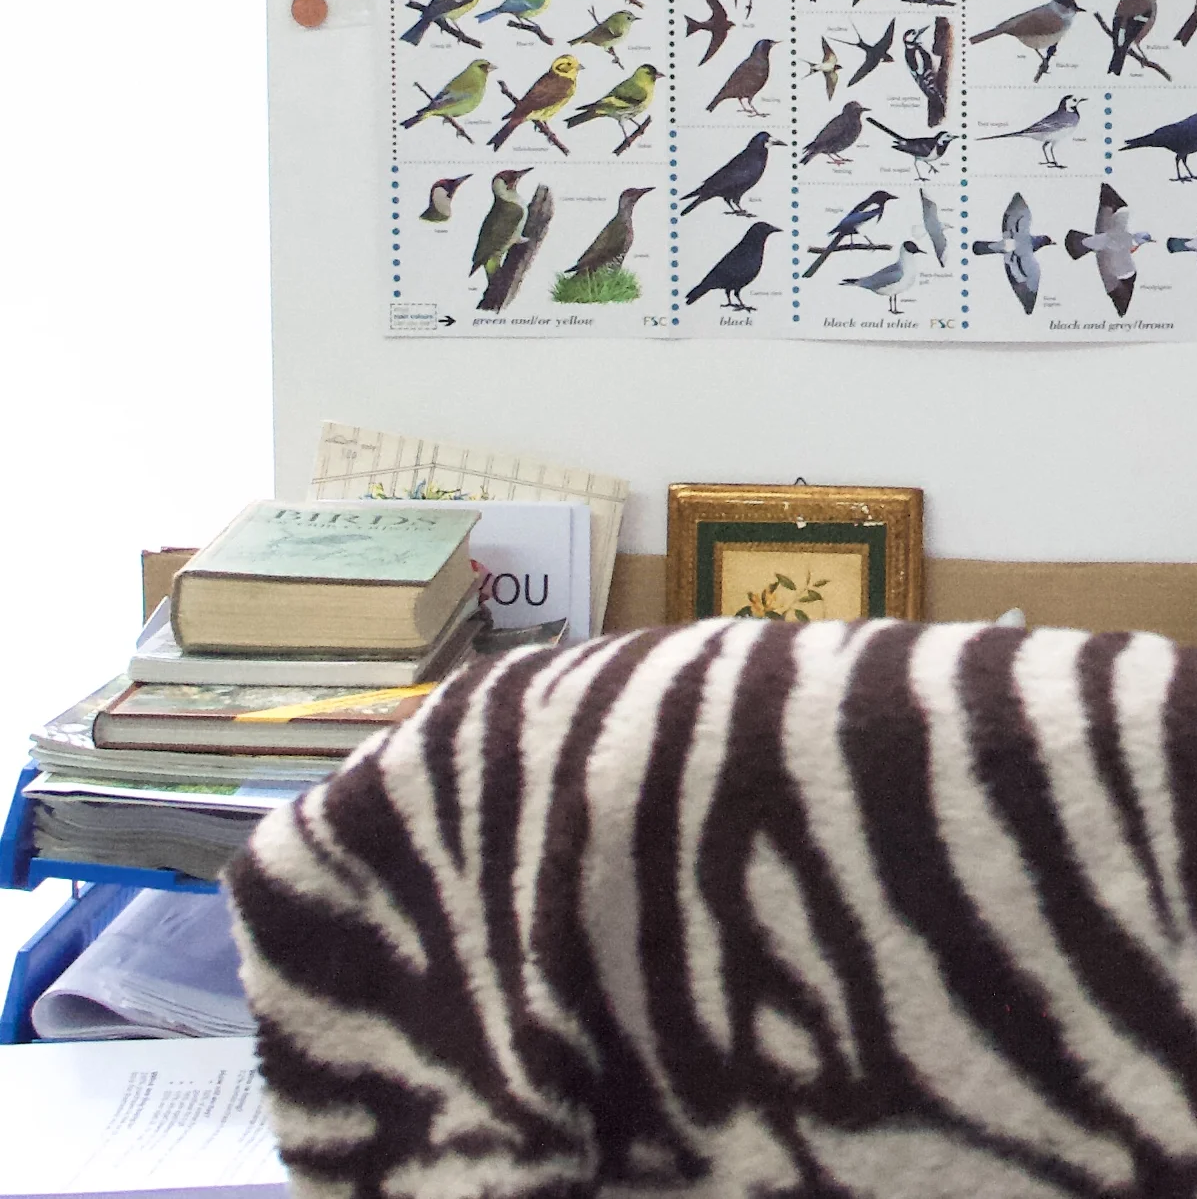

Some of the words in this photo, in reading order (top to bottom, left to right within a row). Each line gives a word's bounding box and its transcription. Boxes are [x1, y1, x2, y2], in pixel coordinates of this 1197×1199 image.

[472, 316, 507, 327] green
[719, 317, 753, 327] black
[823, 318, 856, 328] black
[861, 318, 883, 329] and
[886, 319, 920, 329] white
[930, 319, 955, 329] FSC
[1049, 320, 1081, 331] black
[1084, 320, 1105, 330] and
[1108, 320, 1174, 332] grey/brown
